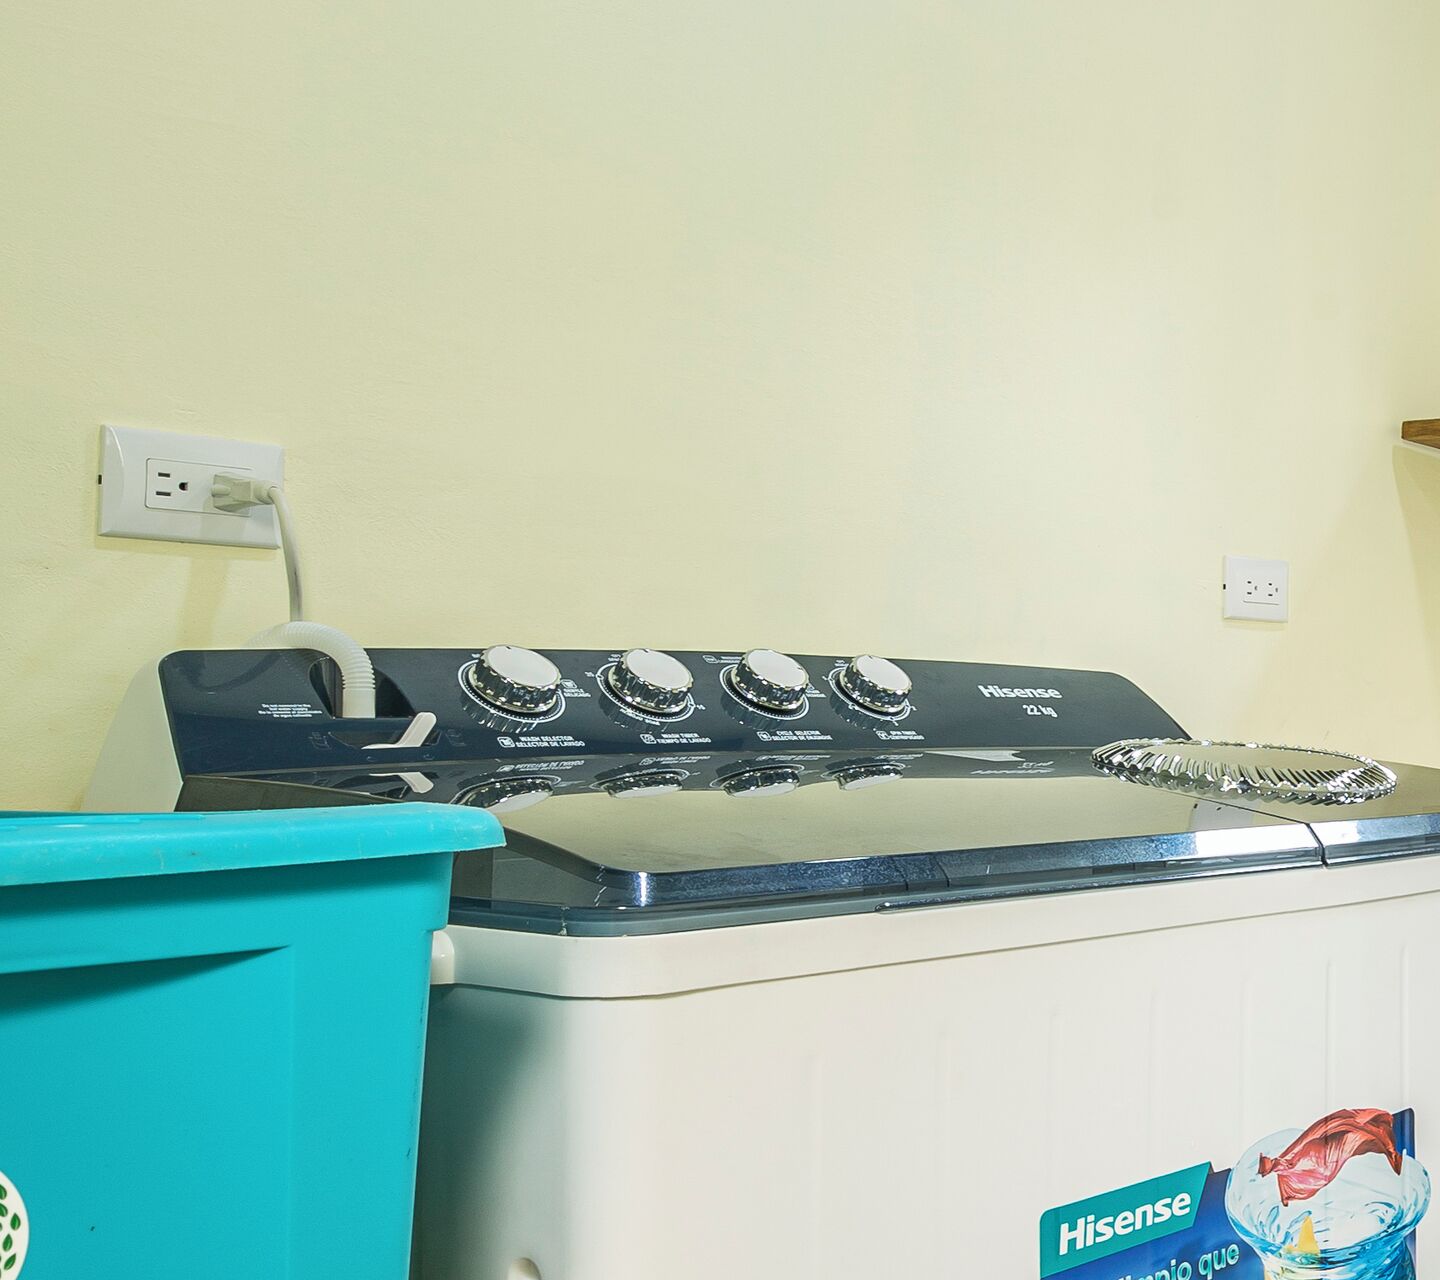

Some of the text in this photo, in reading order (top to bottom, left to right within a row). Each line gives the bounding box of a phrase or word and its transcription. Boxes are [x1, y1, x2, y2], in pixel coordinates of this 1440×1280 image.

[978, 685, 1062, 698] Hisense
[1022, 704, 1058, 717] 22 kg
[1059, 1192, 1192, 1256] Hisense
[1198, 1243, 1240, 1280] que
